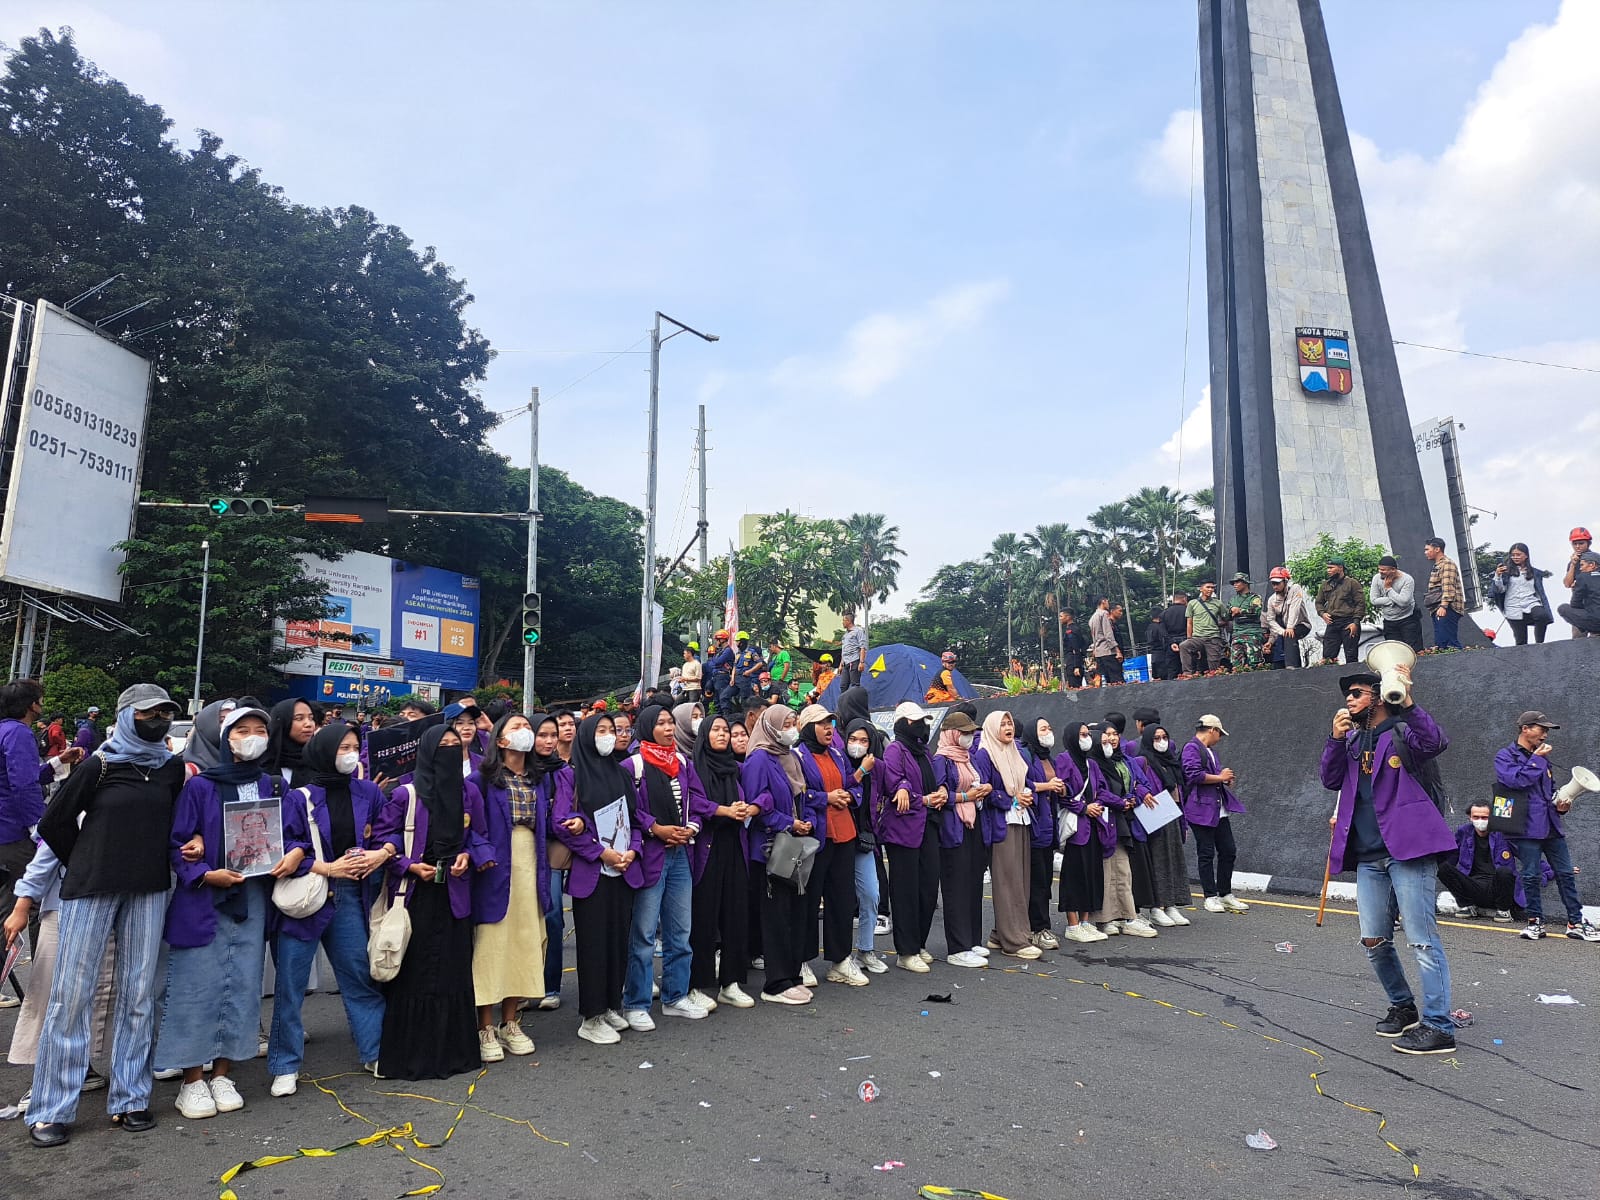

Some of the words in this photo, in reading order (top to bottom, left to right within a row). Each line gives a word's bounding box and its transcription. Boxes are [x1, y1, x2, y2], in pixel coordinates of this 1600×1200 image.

[1302, 328, 1321, 336] KOTA
[1323, 329, 1344, 337] BOGOR
[34, 389, 137, 448] 085891319239
[29, 429, 133, 483] 0251-7539111
[329, 571, 359, 581] University
[432, 590, 459, 601] University
[405, 600, 425, 608] ASEAN
[426, 603, 459, 614] Universities
[415, 629, 427, 640] #1
[450, 635, 465, 647] #3
[328, 661, 365, 673] PESTIGO
[377, 738, 421, 758] REFORM
